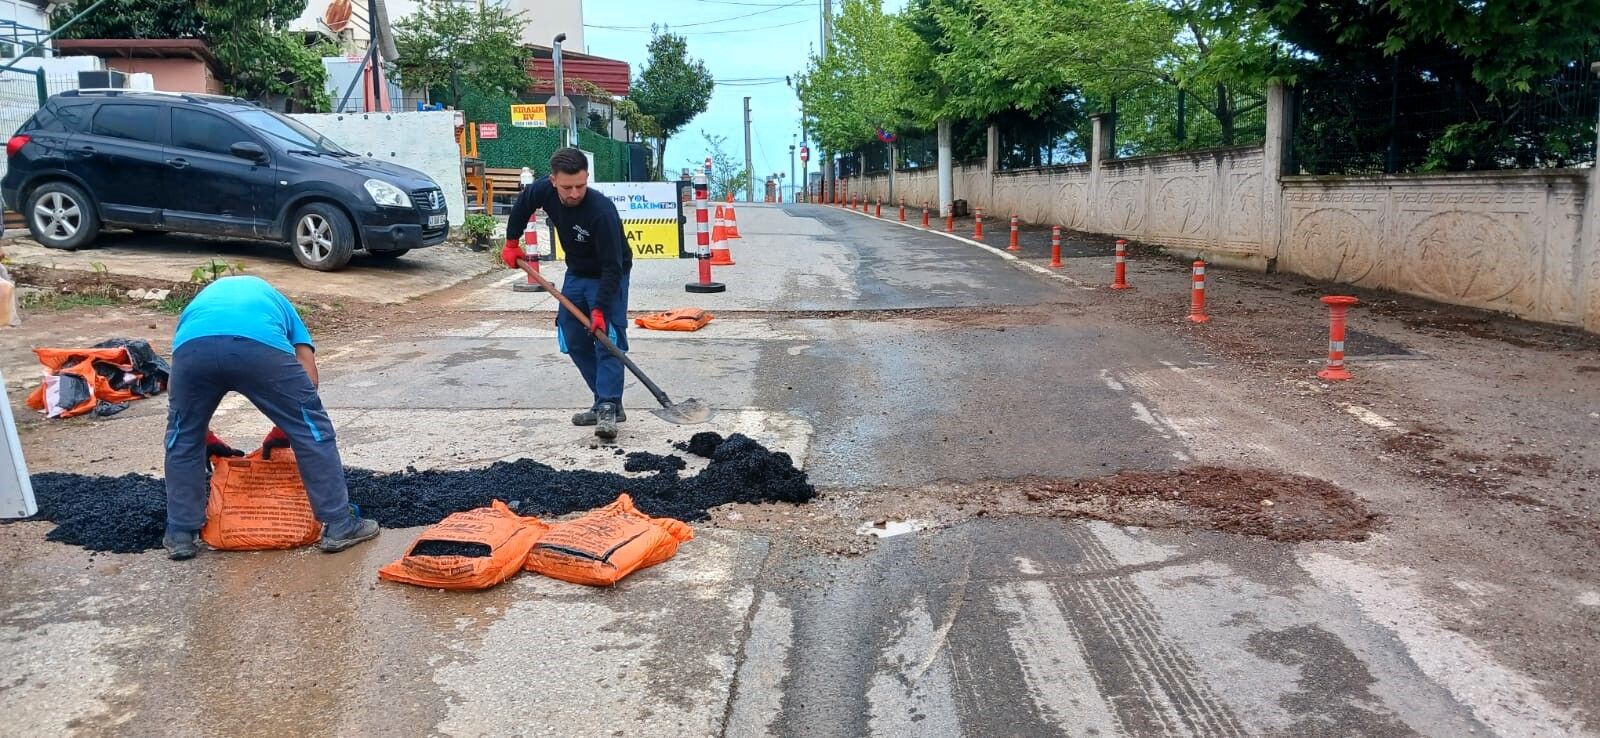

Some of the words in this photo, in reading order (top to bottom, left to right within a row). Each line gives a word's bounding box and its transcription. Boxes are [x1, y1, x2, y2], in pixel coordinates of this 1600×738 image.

[628, 194, 648, 202] YOL
[630, 202, 660, 210] BAKIM
[627, 230, 643, 241] AT
[636, 244, 664, 254] VAR
